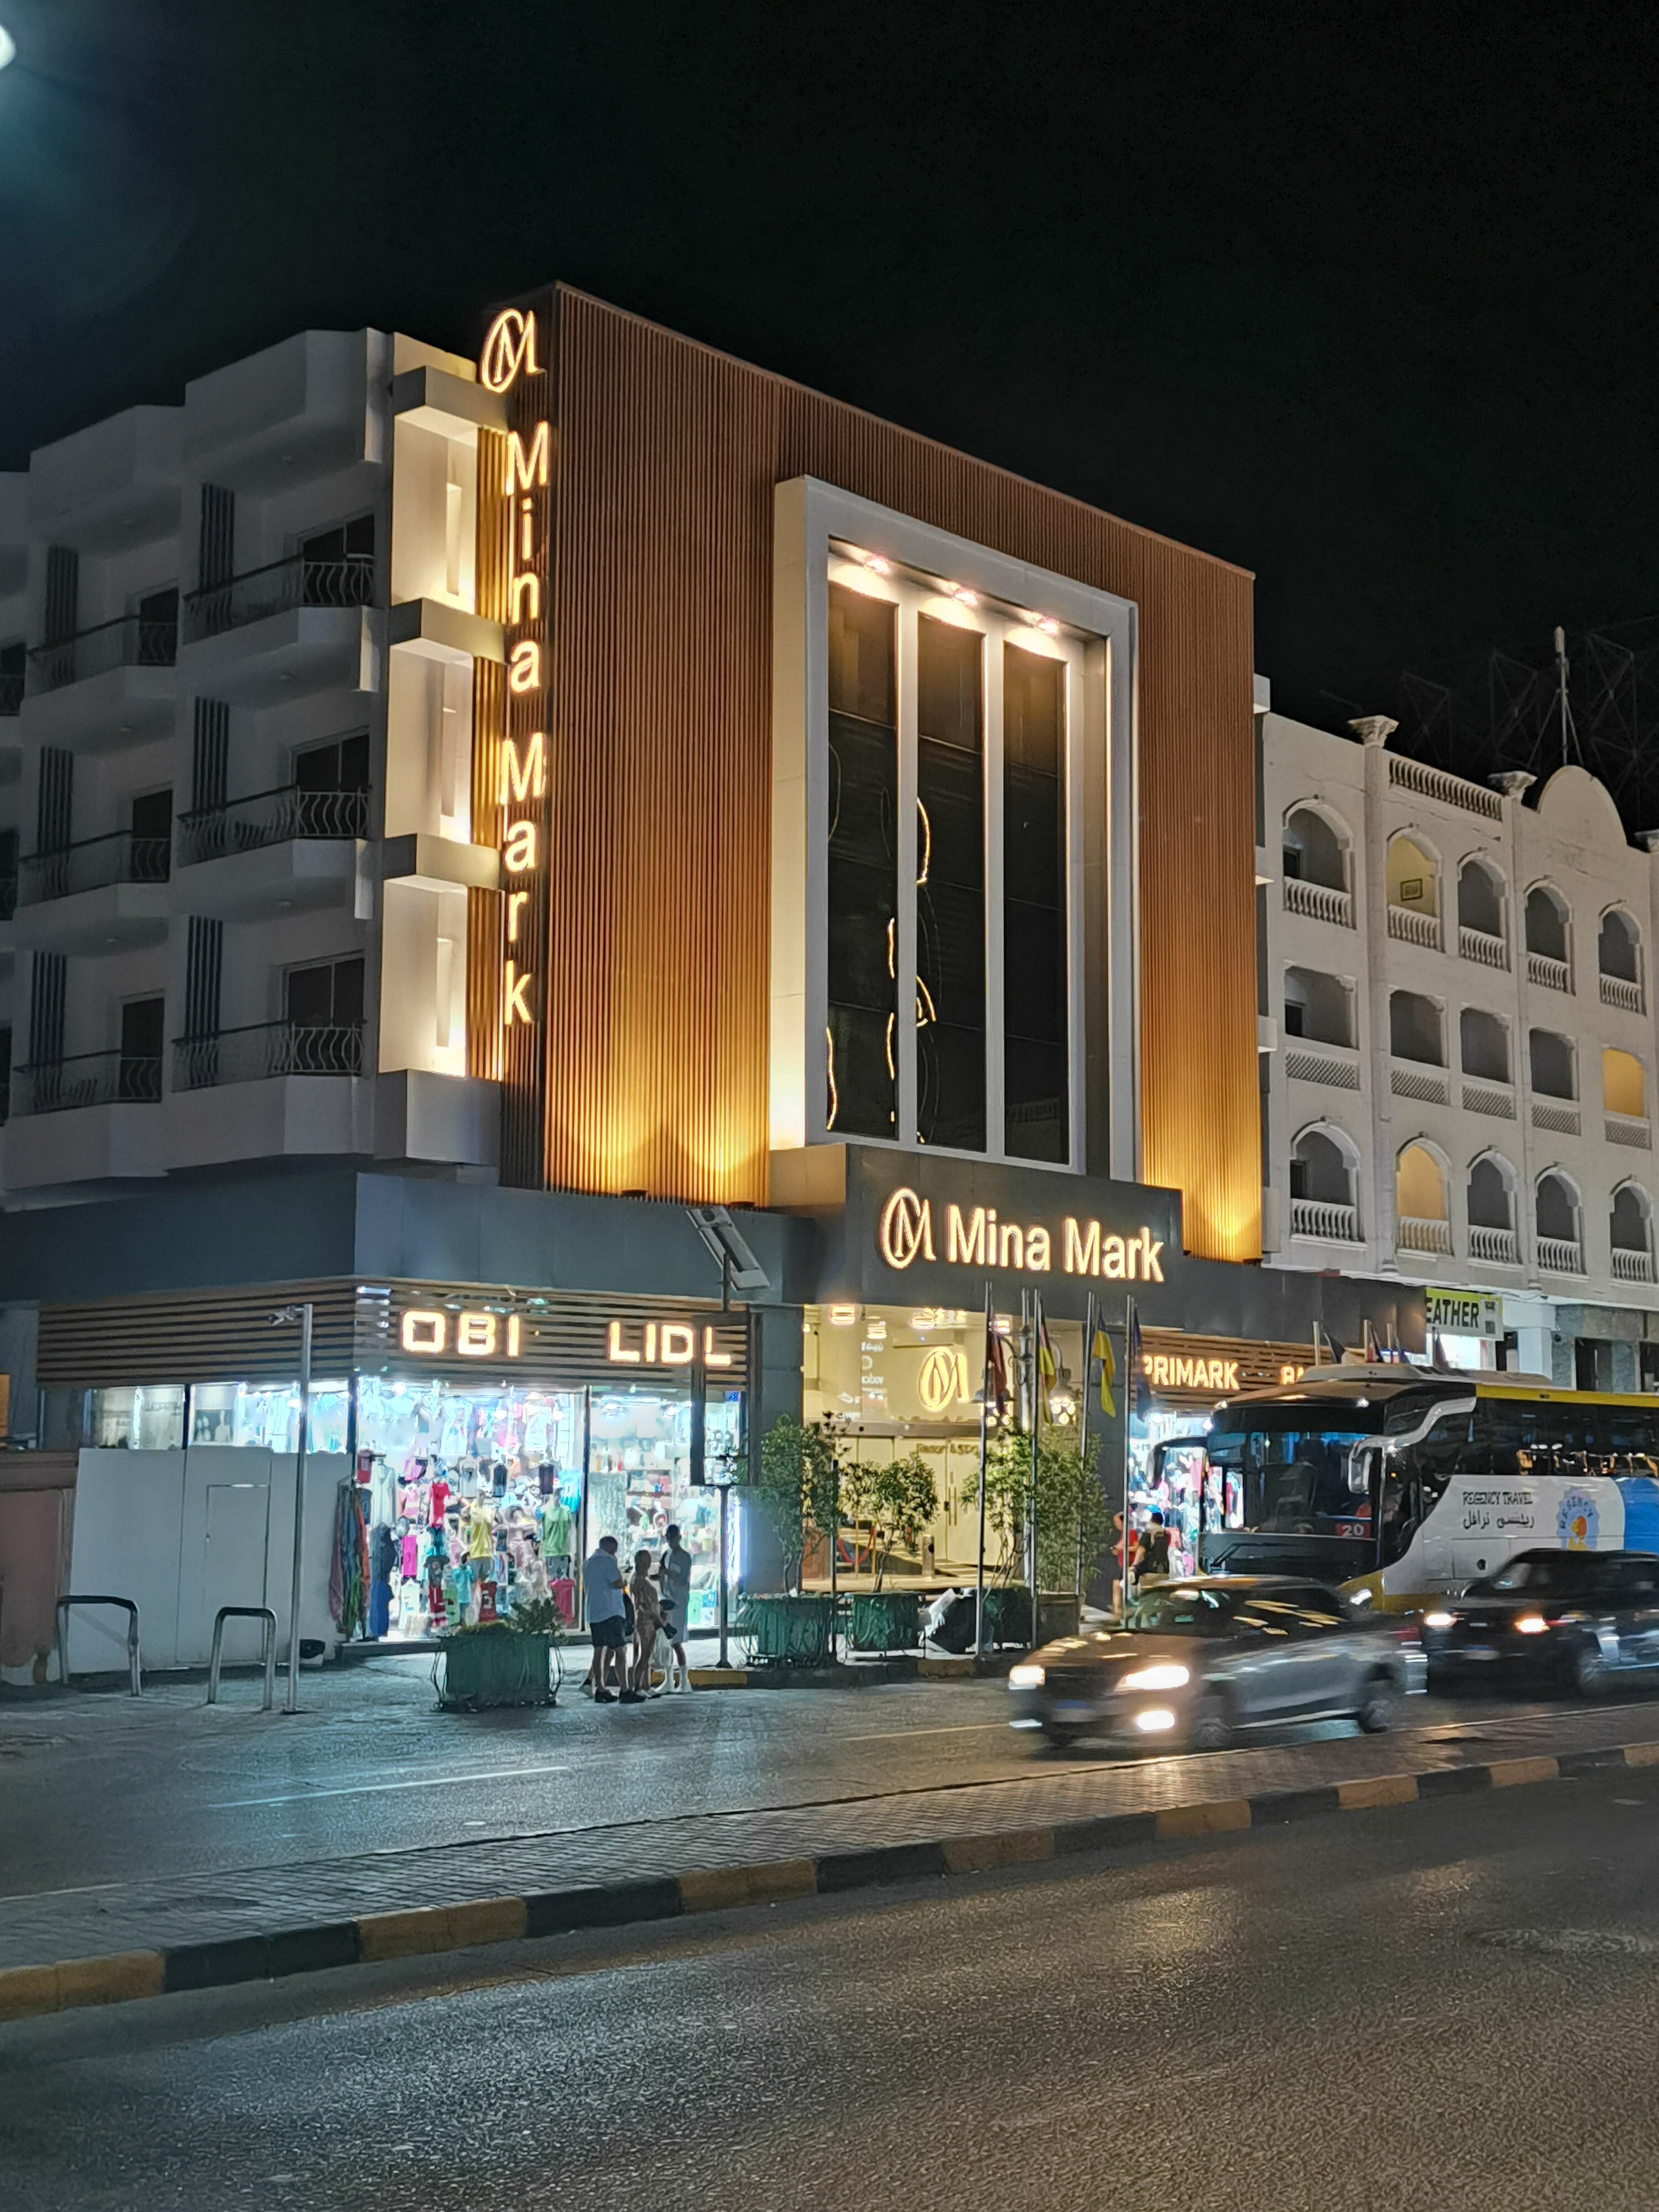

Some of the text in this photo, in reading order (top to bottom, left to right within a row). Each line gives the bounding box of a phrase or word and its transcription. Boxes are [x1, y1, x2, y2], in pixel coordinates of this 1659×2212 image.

[500, 421, 549, 1025] Mina Mark
[947, 1204, 1164, 1282] Mina Mark
[402, 1311, 520, 1357] OBI
[609, 1321, 732, 1366] LIDL
[1342, 1524, 1364, 1537] 20
